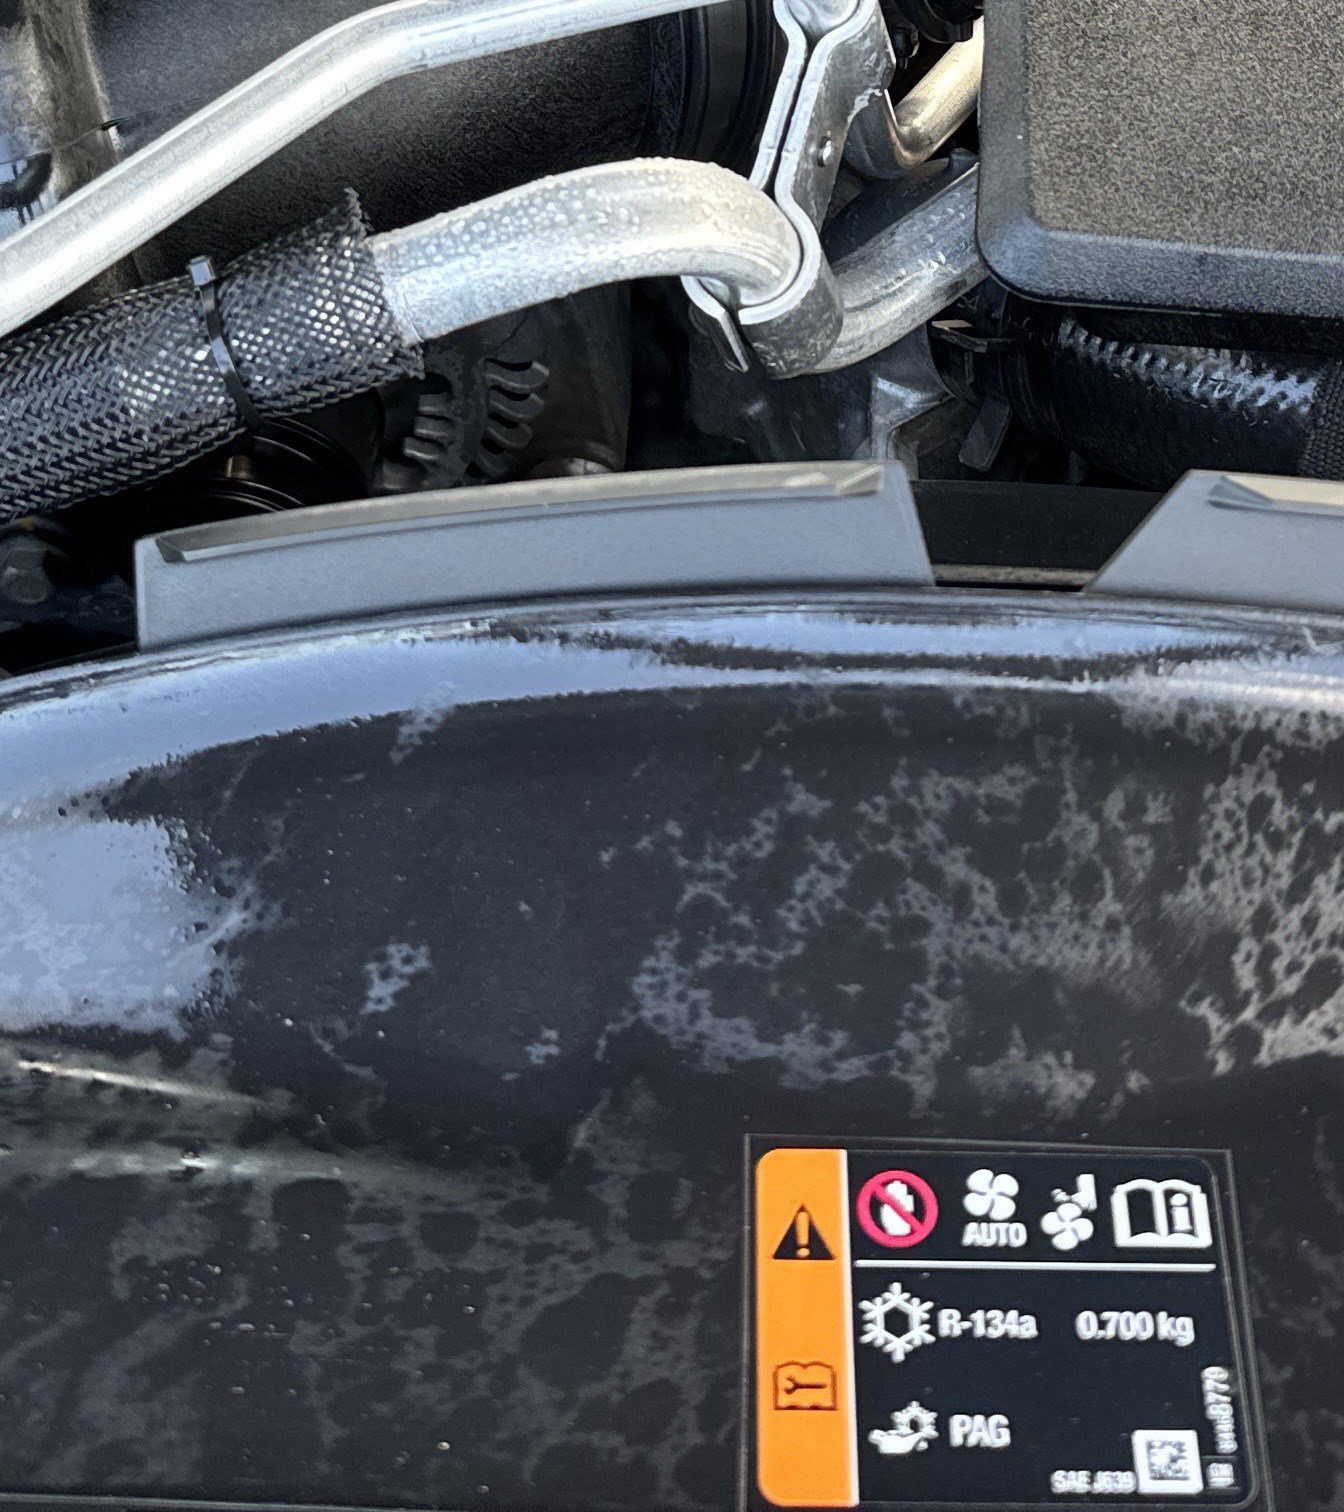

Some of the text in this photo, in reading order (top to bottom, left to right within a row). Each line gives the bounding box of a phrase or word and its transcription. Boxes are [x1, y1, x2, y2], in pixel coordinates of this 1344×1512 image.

[962, 1222, 1027, 1248] AUTO
[938, 1309, 1196, 1346] R-134a 0.700 kg
[949, 1414, 1012, 1449] PAG
